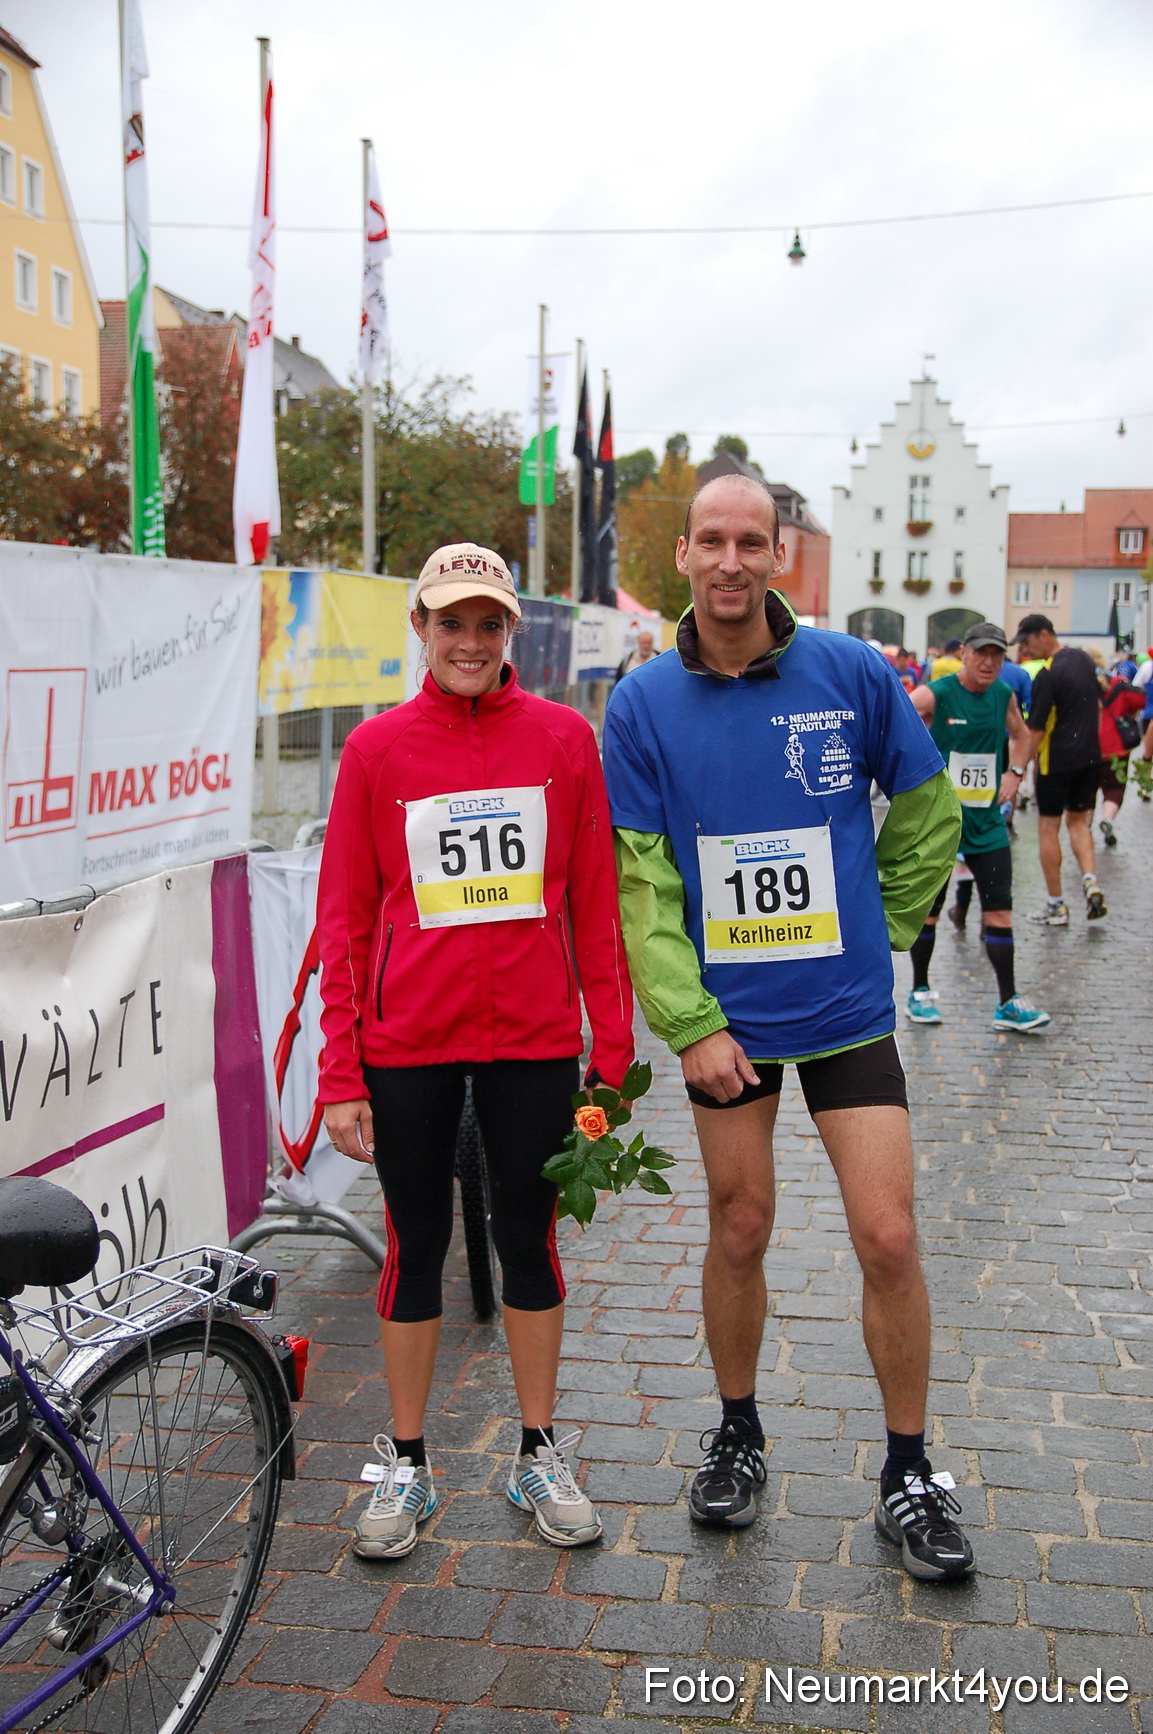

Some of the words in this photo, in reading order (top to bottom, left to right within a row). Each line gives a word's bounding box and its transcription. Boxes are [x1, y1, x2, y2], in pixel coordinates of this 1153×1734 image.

[439, 558, 505, 580] LEVI'S
[95, 656, 127, 695] wir
[130, 639, 182, 681] bauen
[185, 613, 208, 655] für
[770, 715, 789, 726] 12.
[788, 710, 855, 724] NEUMARKTER
[788, 720, 842, 734] STADTLAUF
[88, 764, 159, 816] MAX
[169, 746, 231, 801] BÖGL
[961, 768, 988, 788] 675
[449, 797, 504, 815] BOCK
[438, 823, 526, 877] 516
[734, 838, 790, 856] BOCK
[463, 886, 509, 905] Ilona
[724, 864, 811, 916] 189
[729, 923, 813, 945] Karlheinz
